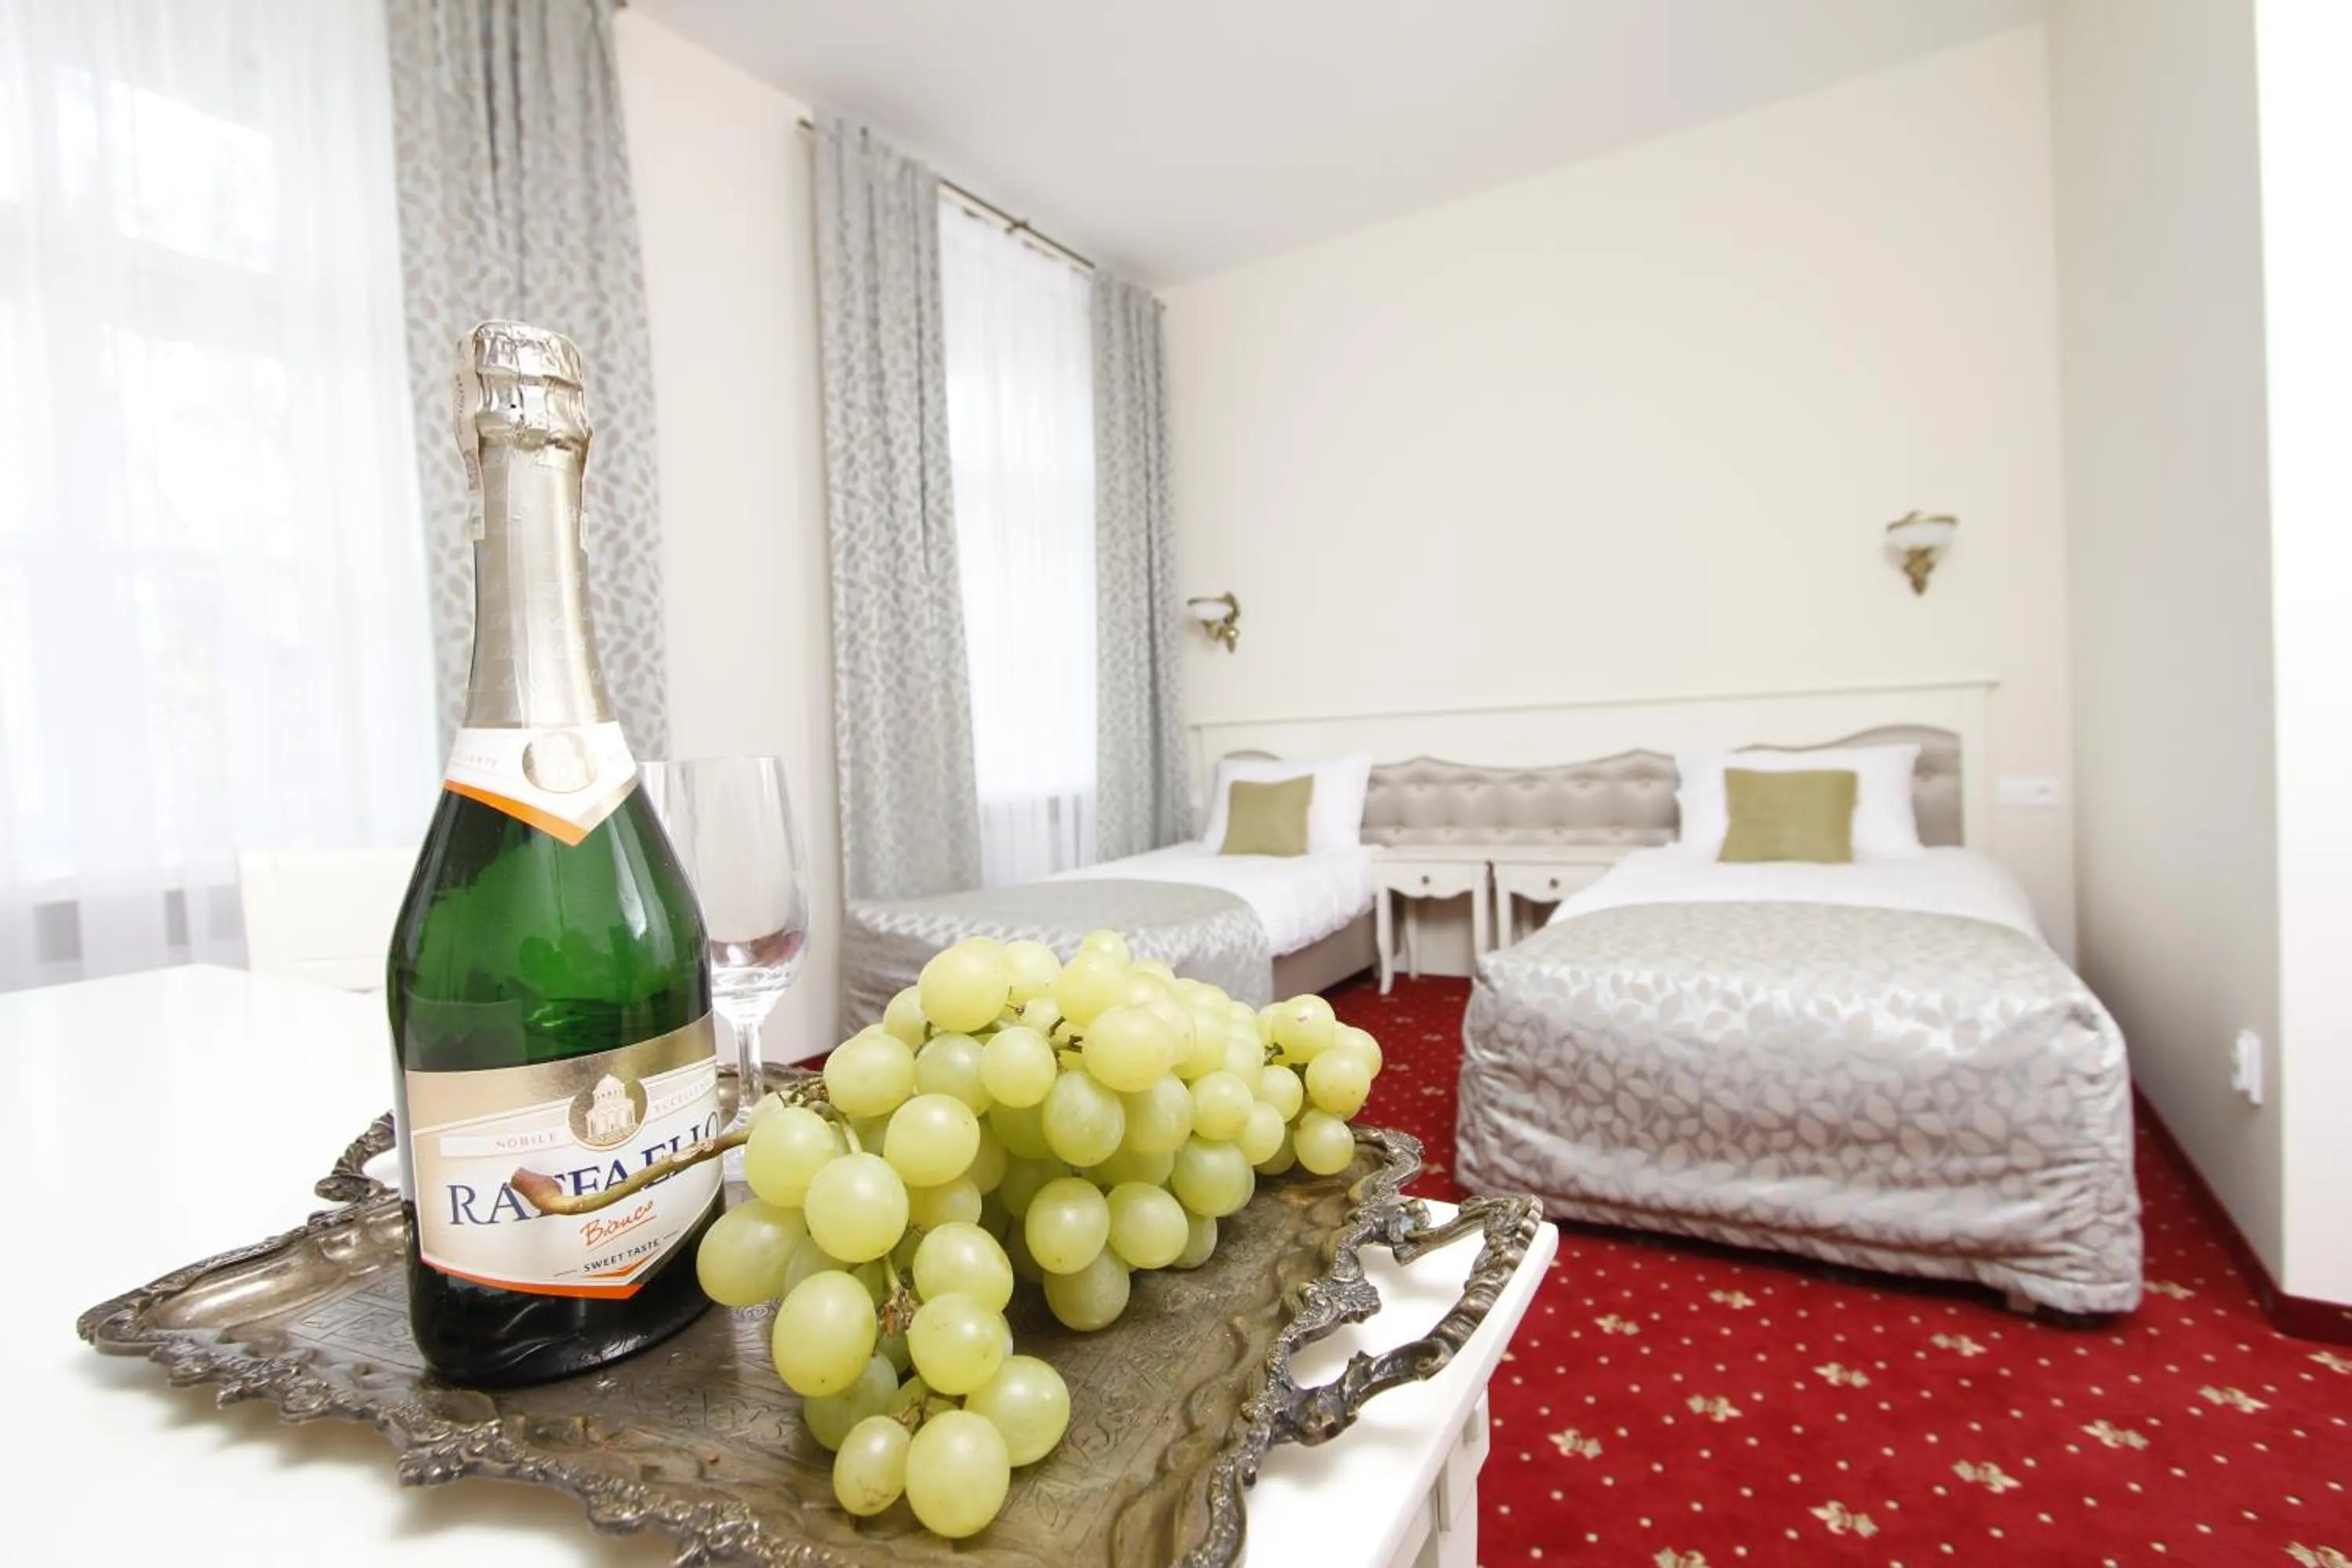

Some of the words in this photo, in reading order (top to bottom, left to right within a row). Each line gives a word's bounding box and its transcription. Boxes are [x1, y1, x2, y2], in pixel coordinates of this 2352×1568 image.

[446, 1111, 720, 1225] RAFAEO
[583, 1253, 624, 1272] SWEET
[626, 1238, 660, 1258] TASTE
